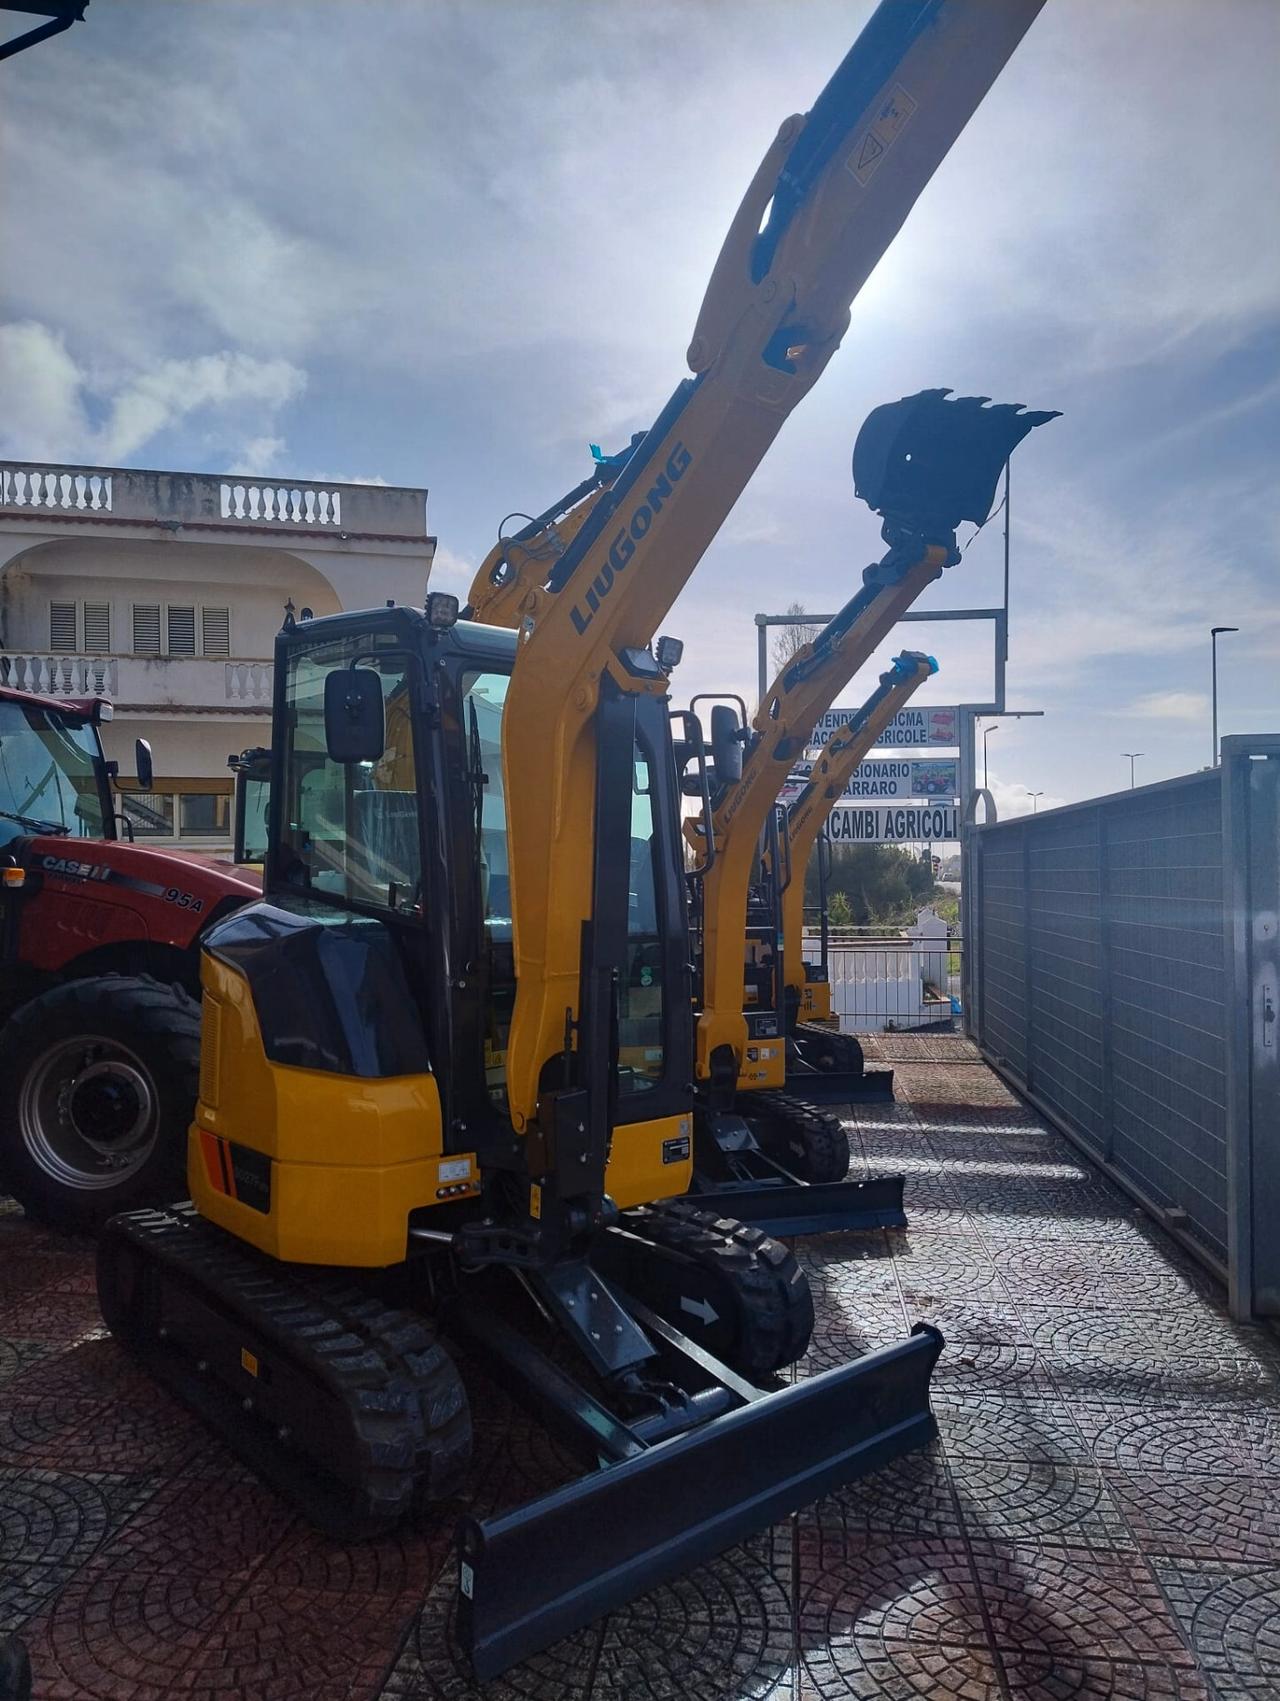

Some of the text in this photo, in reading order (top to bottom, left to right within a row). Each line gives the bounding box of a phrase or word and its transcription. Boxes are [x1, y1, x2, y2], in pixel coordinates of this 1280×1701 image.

[569, 441, 692, 635] LIUGONG
[877, 729, 927, 744] GRICOLE
[852, 763, 910, 778] SIONARIO
[843, 781, 897, 795] ARRARO
[826, 809, 957, 839] ICAMBI AGRICOLI
[165, 888, 203, 913] 95A
